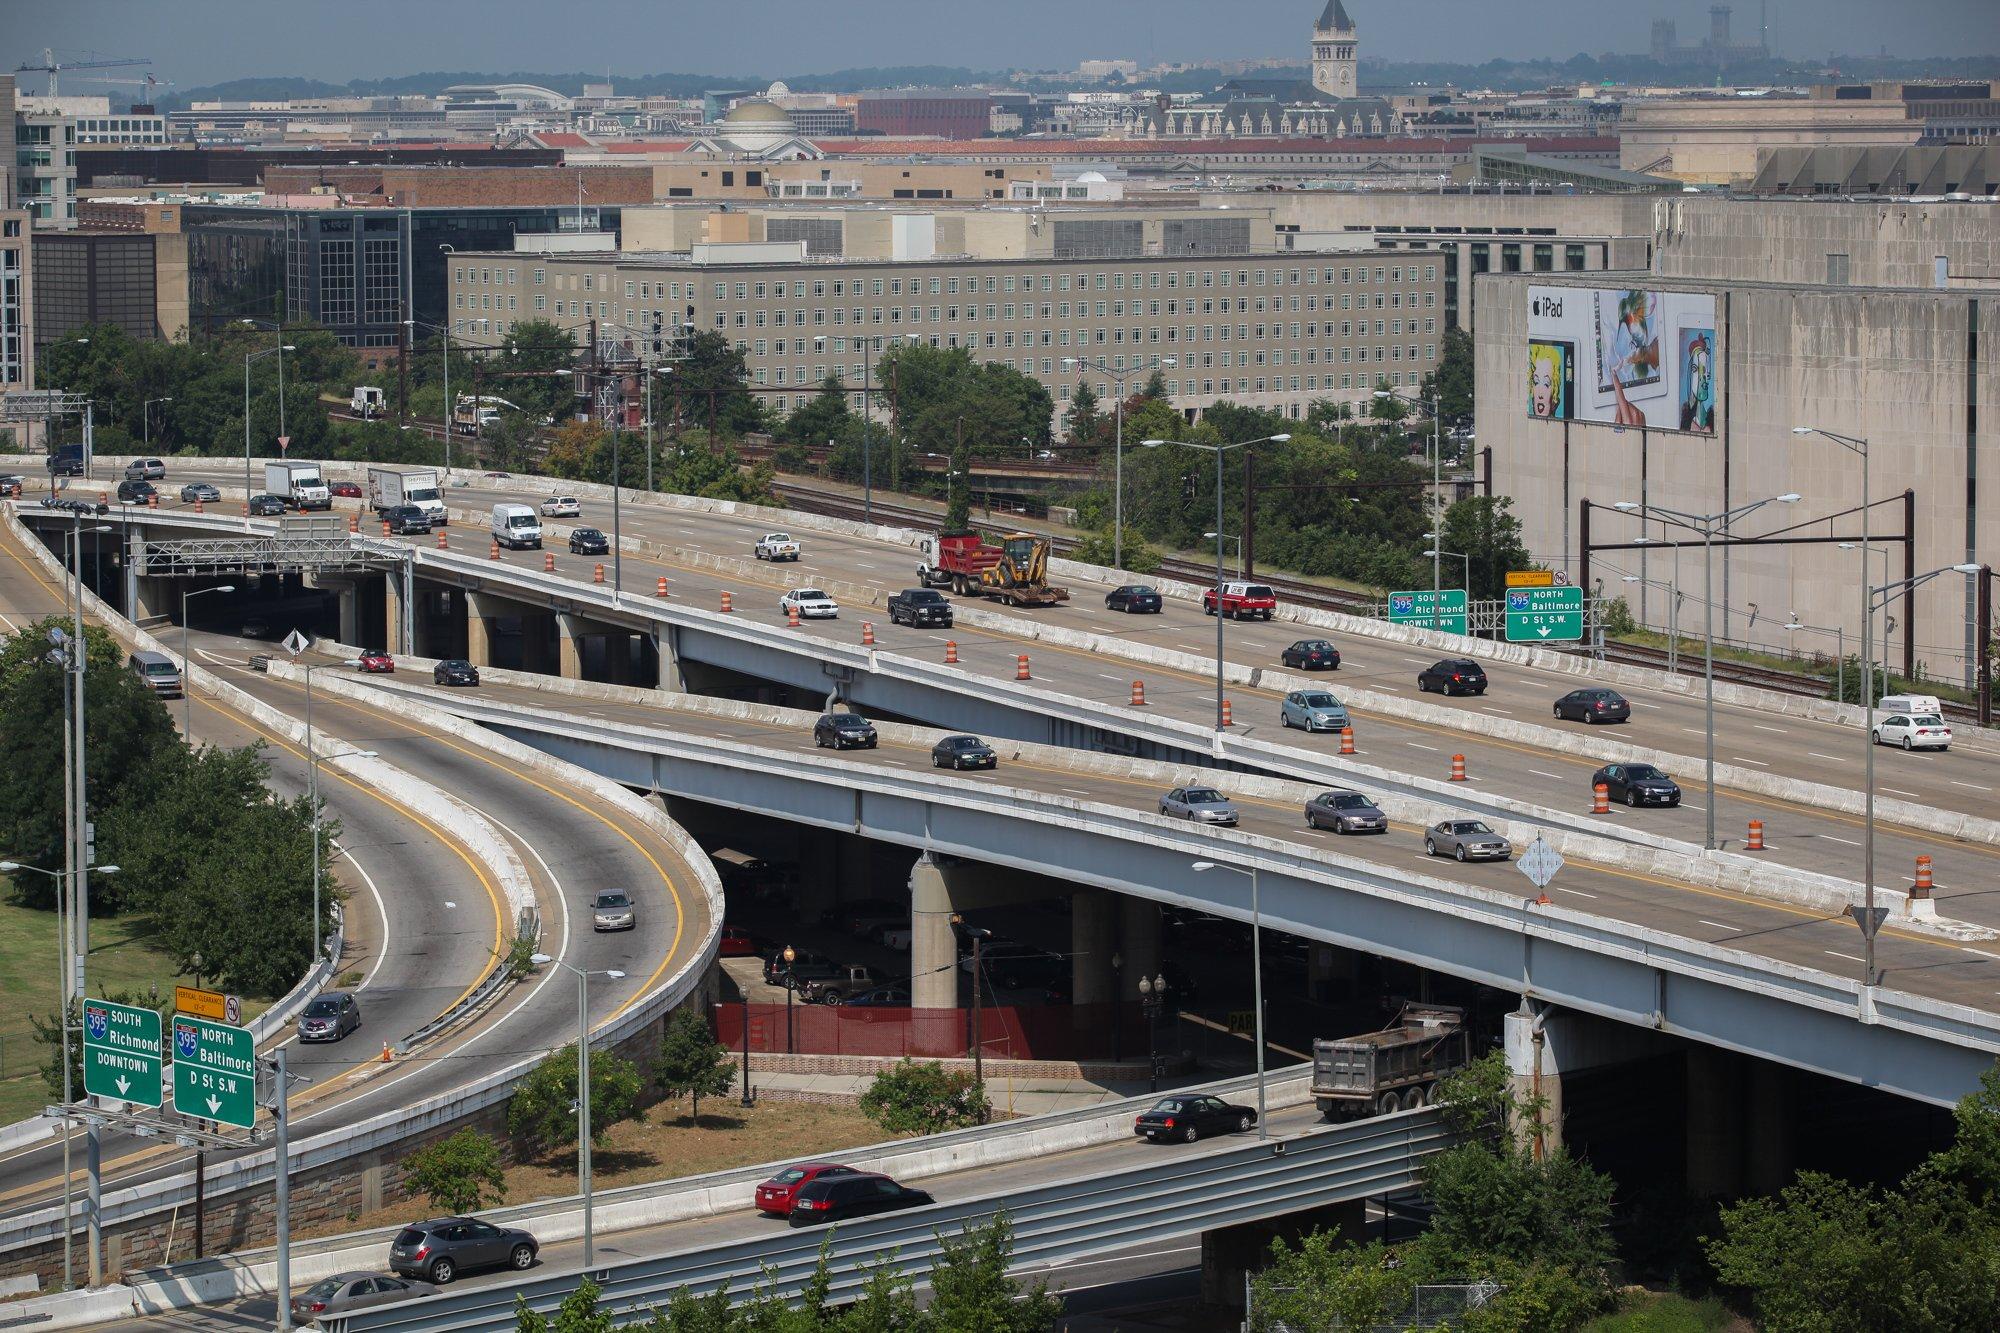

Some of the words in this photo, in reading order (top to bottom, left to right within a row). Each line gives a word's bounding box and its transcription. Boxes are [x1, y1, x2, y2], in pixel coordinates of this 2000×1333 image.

[1542, 297, 1562, 318] iPad
[1395, 600, 1412, 609] 395
[1418, 594, 1447, 602] SOUH
[1512, 597, 1528, 605] 395
[1532, 602, 1580, 610] Baltimore
[1522, 616, 1528, 624] D
[1534, 616, 1544, 624] St
[1549, 615, 1566, 623] S.W.
[198, 994, 223, 1006] CLEARANCE
[89, 1014, 106, 1031] 395
[111, 1010, 141, 1027] SOUTH
[110, 1031, 159, 1053] Richmond
[178, 1032, 196, 1049] 395
[202, 1028, 233, 1046] NORTH
[98, 1053, 148, 1074] DOWNTOWN
[200, 1049, 252, 1072] Baltimore
[191, 1071, 197, 1084] D
[203, 1074, 213, 1089] St
[218, 1077, 237, 1094] S.W.
